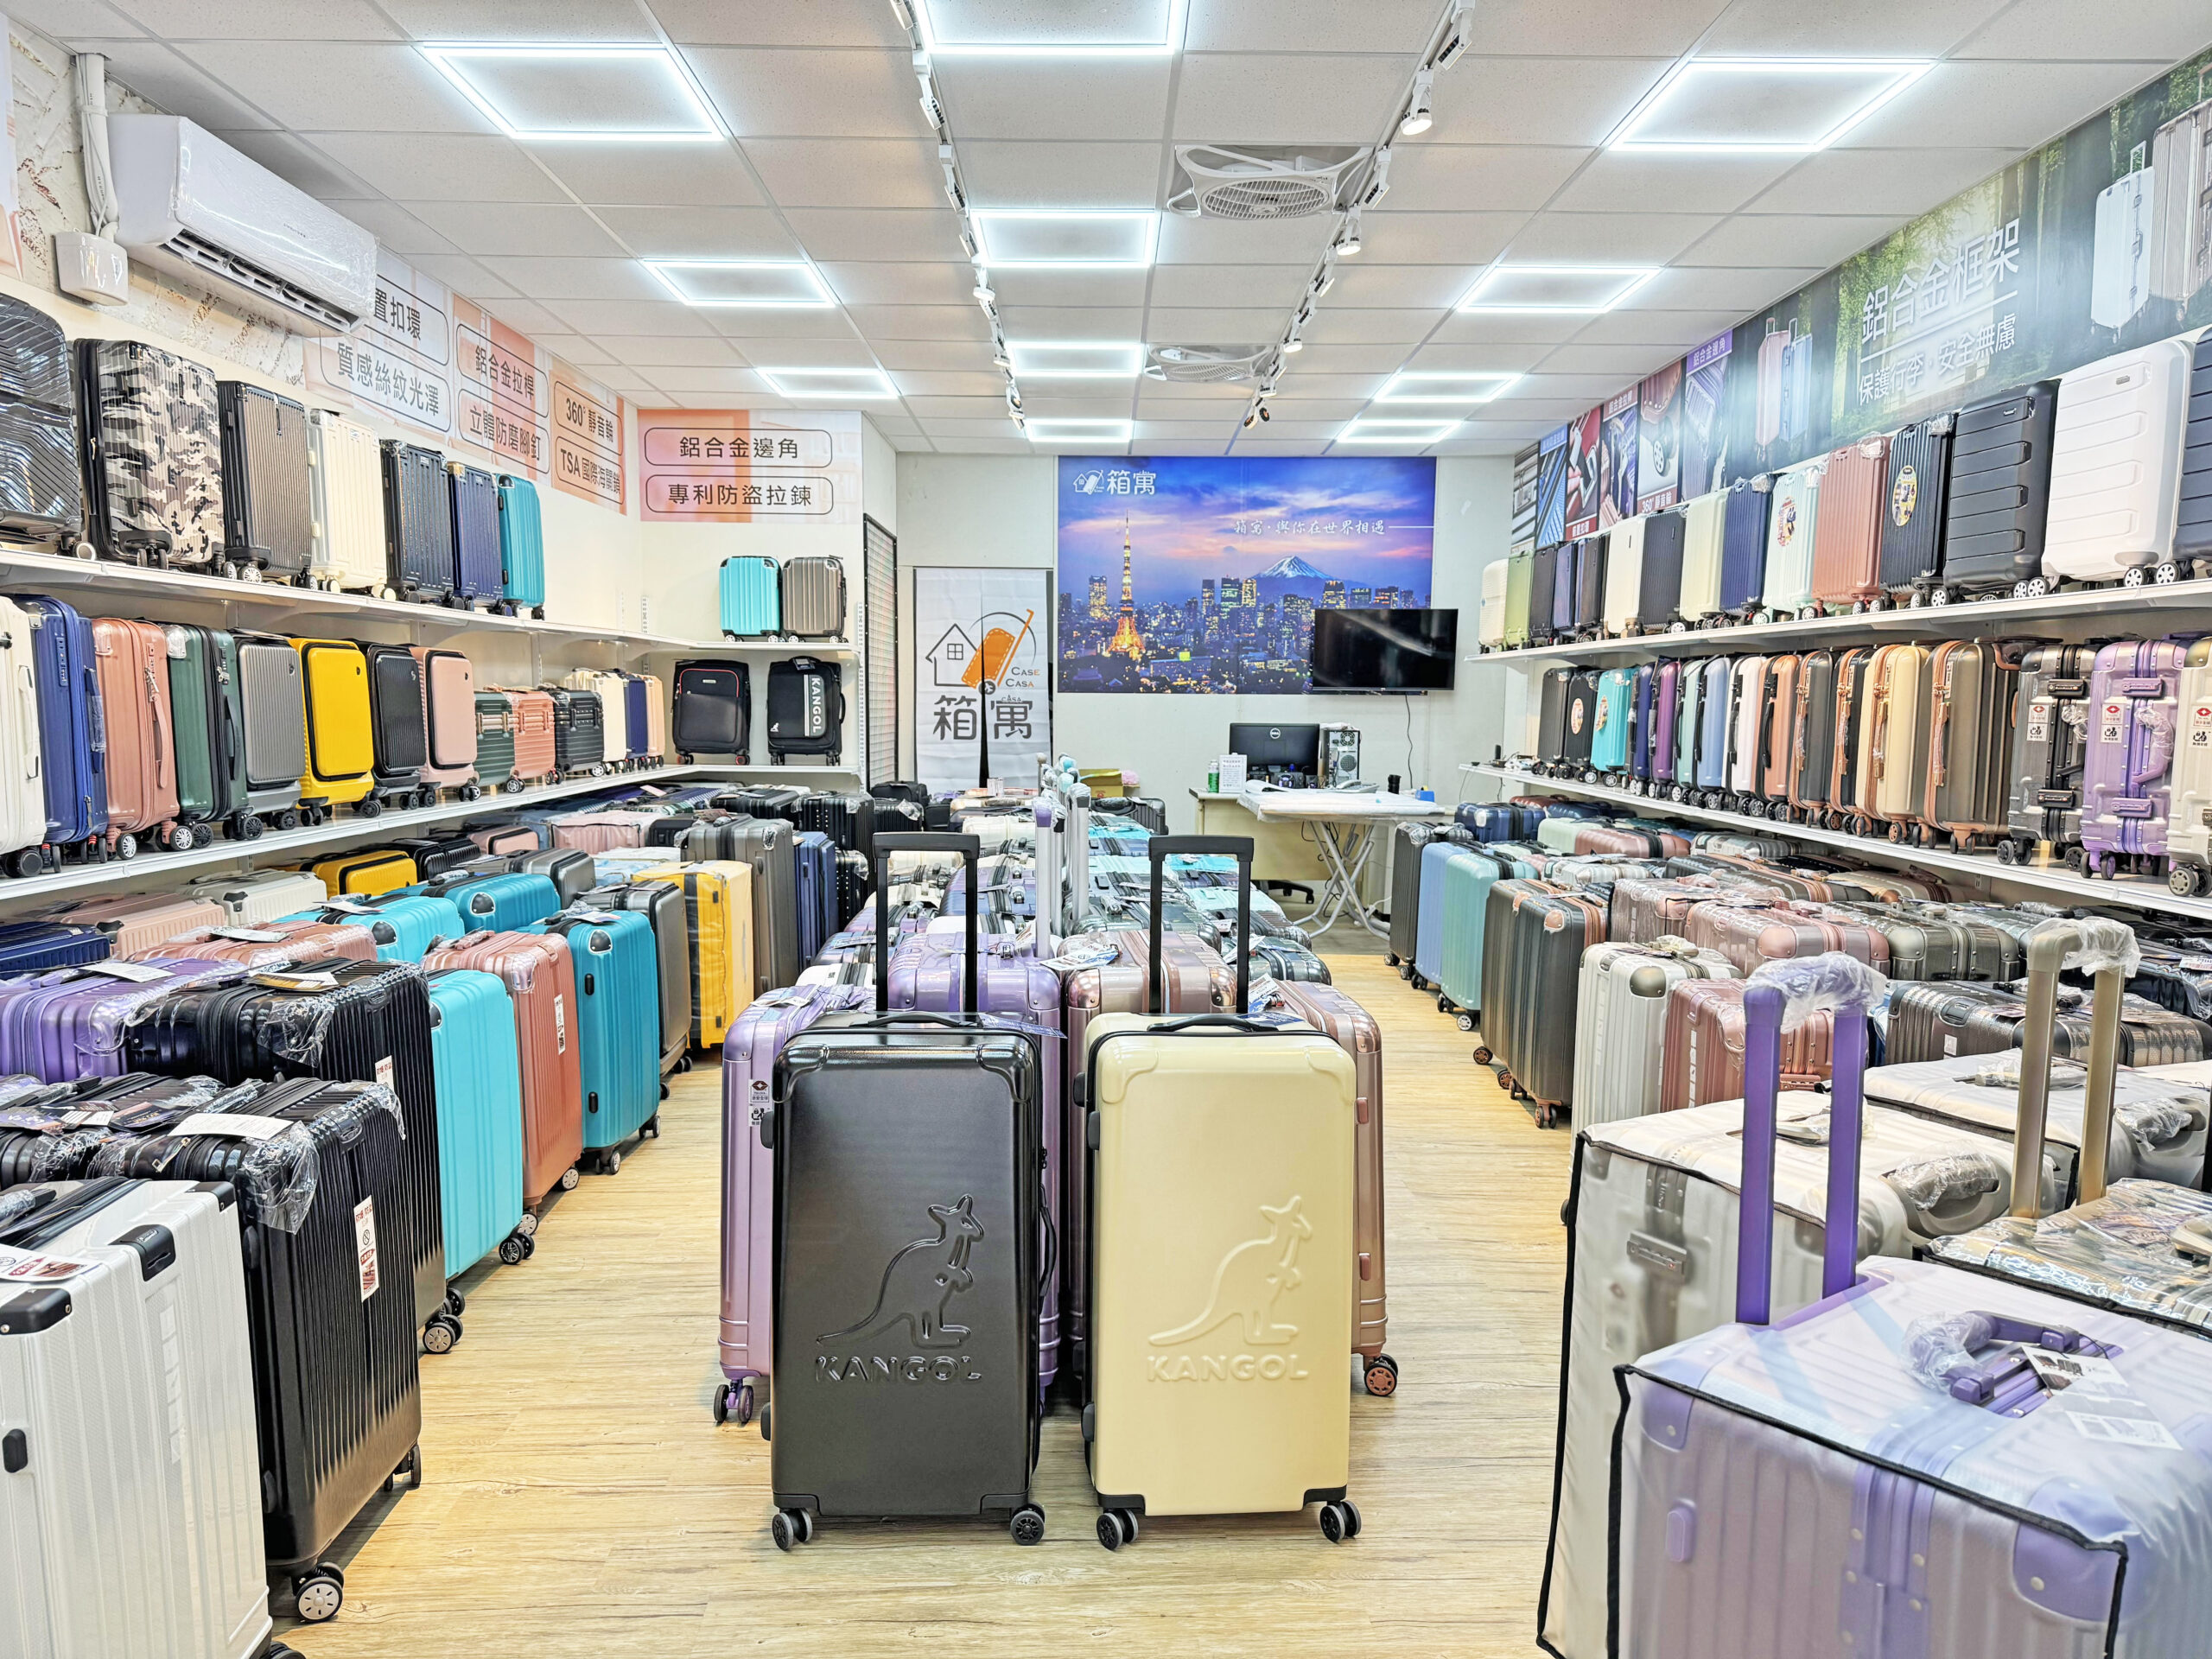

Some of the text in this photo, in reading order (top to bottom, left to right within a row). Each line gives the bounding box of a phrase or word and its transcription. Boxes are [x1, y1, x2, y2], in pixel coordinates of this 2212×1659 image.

[1861, 218, 2020, 344] 鋁合金框架
[337, 342, 439, 416] 質感絲紋光澤
[475, 346, 534, 401] 鋁合金拉桿
[470, 405, 541, 461] 立體防磨腳釘
[679, 435, 798, 459] 鋁合金邊角
[561, 448, 582, 478] TSA
[668, 483, 811, 507] 專利防盜拉鍊
[1107, 469, 1156, 495] 箱寓
[1005, 678, 1035, 688] CASA
[810, 677, 822, 734] KANGOL
[932, 695, 1033, 741] 箱寓
[815, 1355, 982, 1382] KANGOL
[1147, 1354, 1309, 1382] KANGOL
